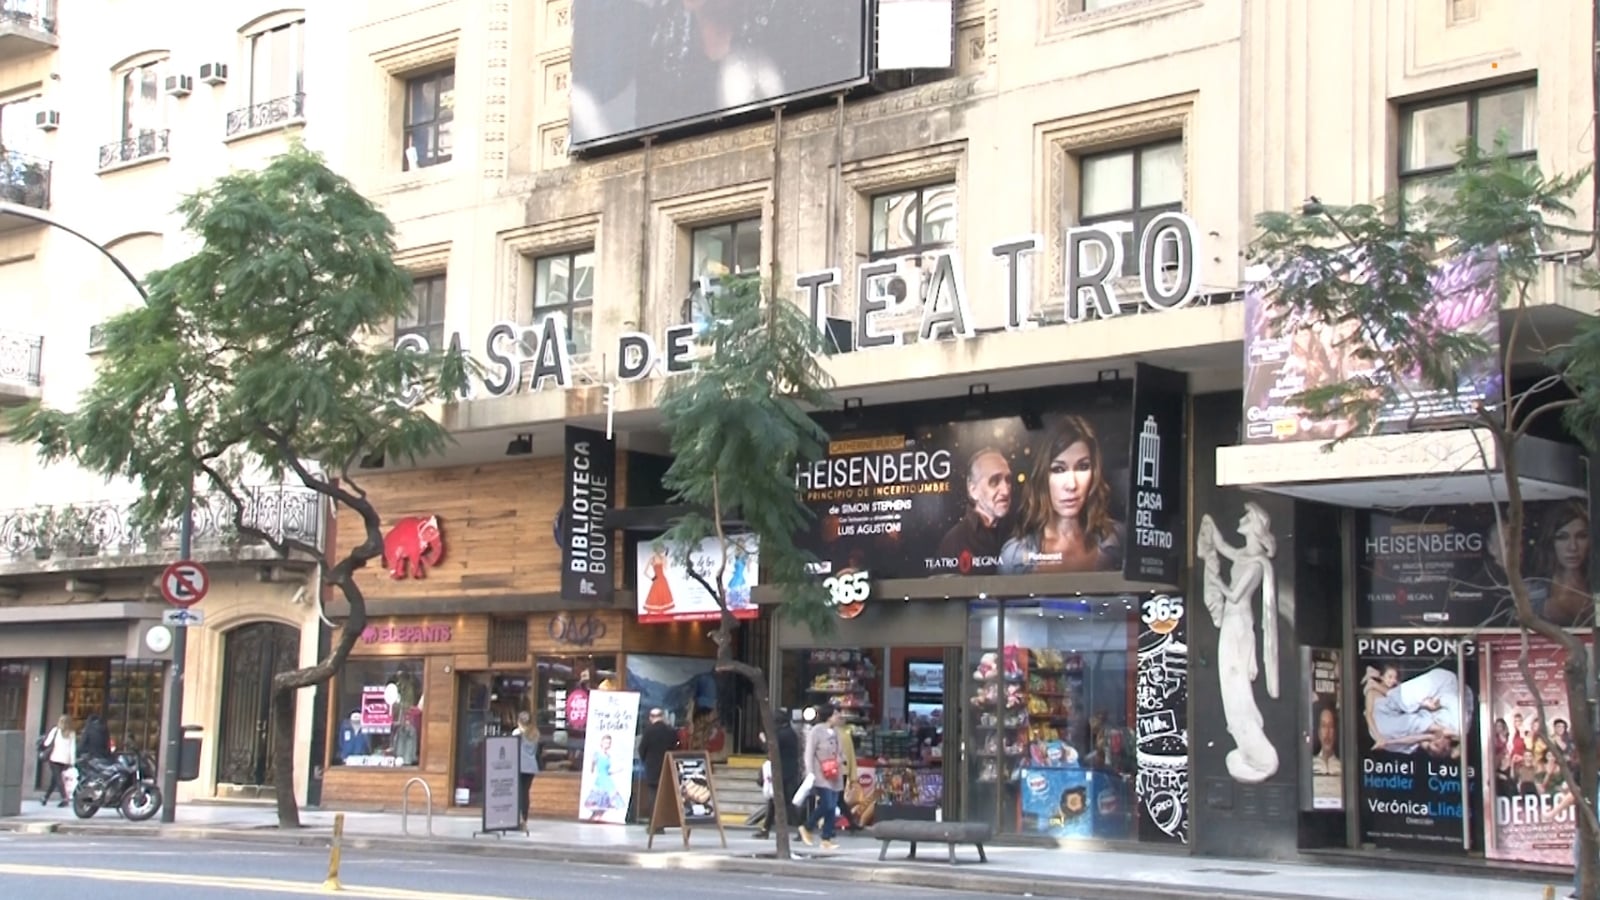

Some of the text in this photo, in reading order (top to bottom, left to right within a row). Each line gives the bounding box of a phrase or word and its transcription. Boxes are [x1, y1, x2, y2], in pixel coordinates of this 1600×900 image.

[796, 211, 1203, 352] TEATRO
[795, 449, 951, 490] HEISENBERG
[807, 489, 853, 501] PRINCIPIO
[857, 489, 869, 498] DE
[873, 481, 951, 496] INCERTIDUMBRE
[1136, 491, 1163, 510] CASA
[571, 441, 590, 573] BIBLIOTECA
[829, 499, 912, 515] de SIMON STEPHENS
[589, 475, 608, 575] BOUTIQUE
[1135, 510, 1155, 528] DEL
[837, 522, 902, 537] LUIS AGUSTONI
[1135, 528, 1173, 549] TEATRO
[1365, 532, 1483, 554] HEISENBERG
[924, 556, 1004, 569] TEATRO REGINA
[823, 572, 870, 604] 365
[1141, 597, 1184, 624] 365
[1363, 758, 1475, 778] Daniel Laua
[1363, 774, 1414, 790] Hendler
[1367, 797, 1429, 816] Verónica
